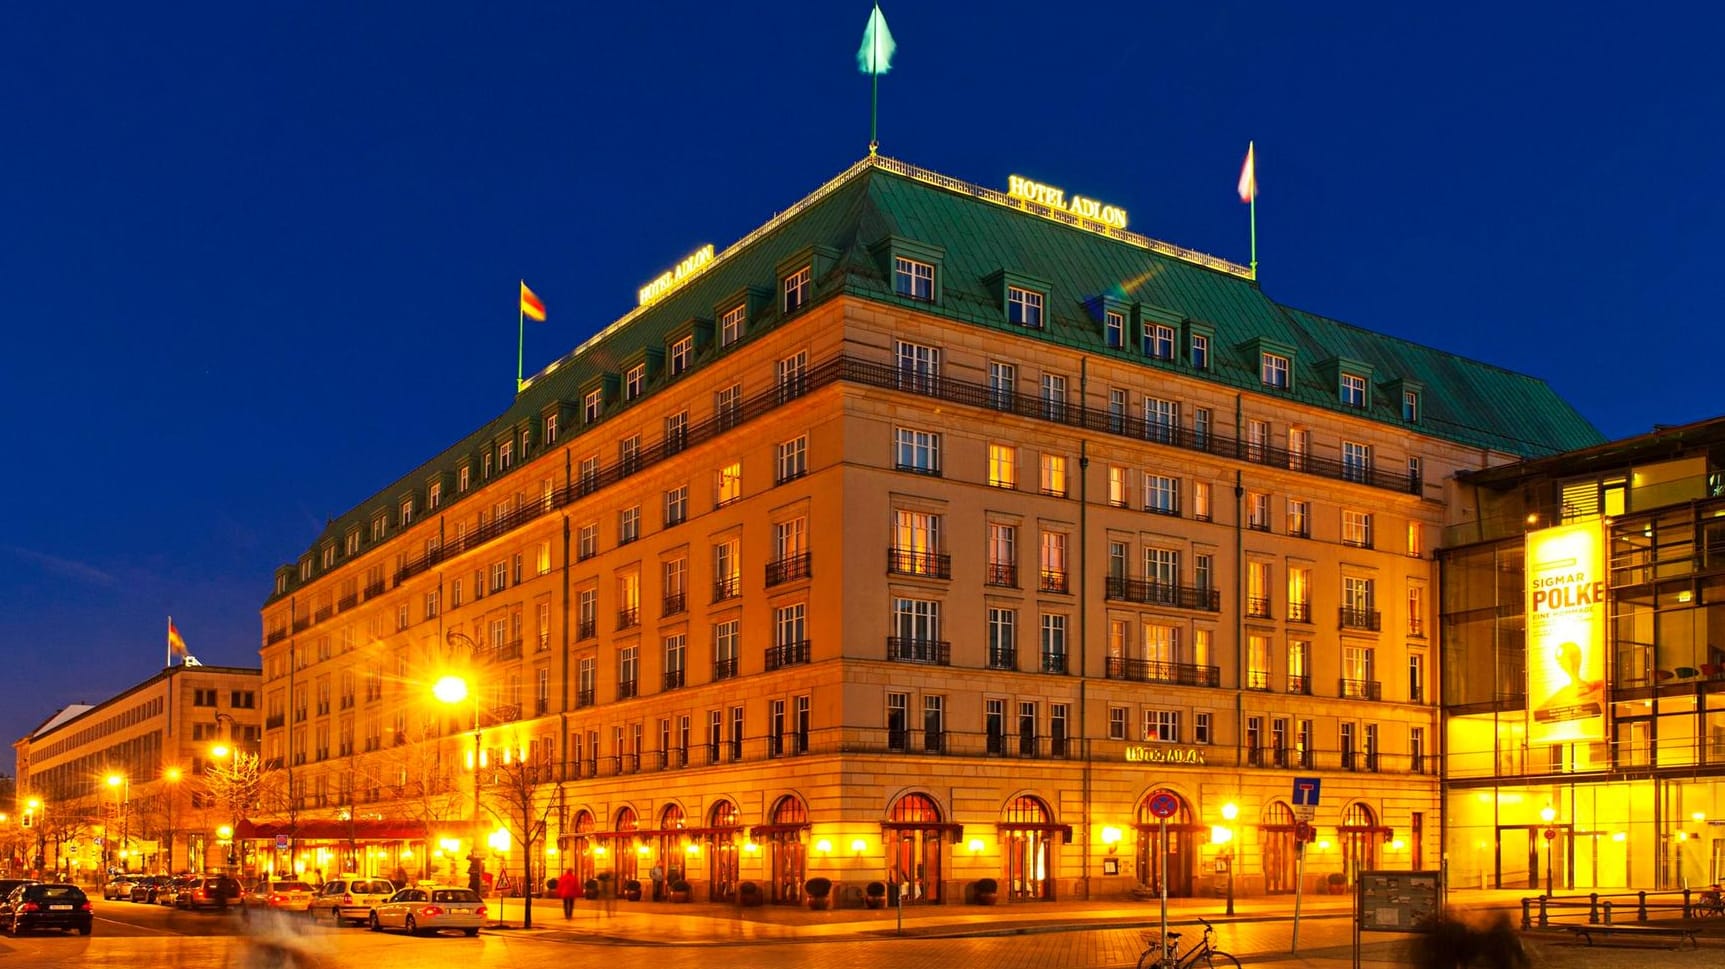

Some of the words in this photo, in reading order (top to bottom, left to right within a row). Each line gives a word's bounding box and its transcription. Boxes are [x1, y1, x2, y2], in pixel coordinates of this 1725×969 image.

[1008, 174, 1067, 210] HOTEL
[1070, 195, 1127, 229] ADLON
[639, 270, 673, 305] HOTEL
[674, 243, 714, 282] ADLON
[1532, 572, 1584, 588] SIGMAR
[1532, 581, 1604, 612] POLKE
